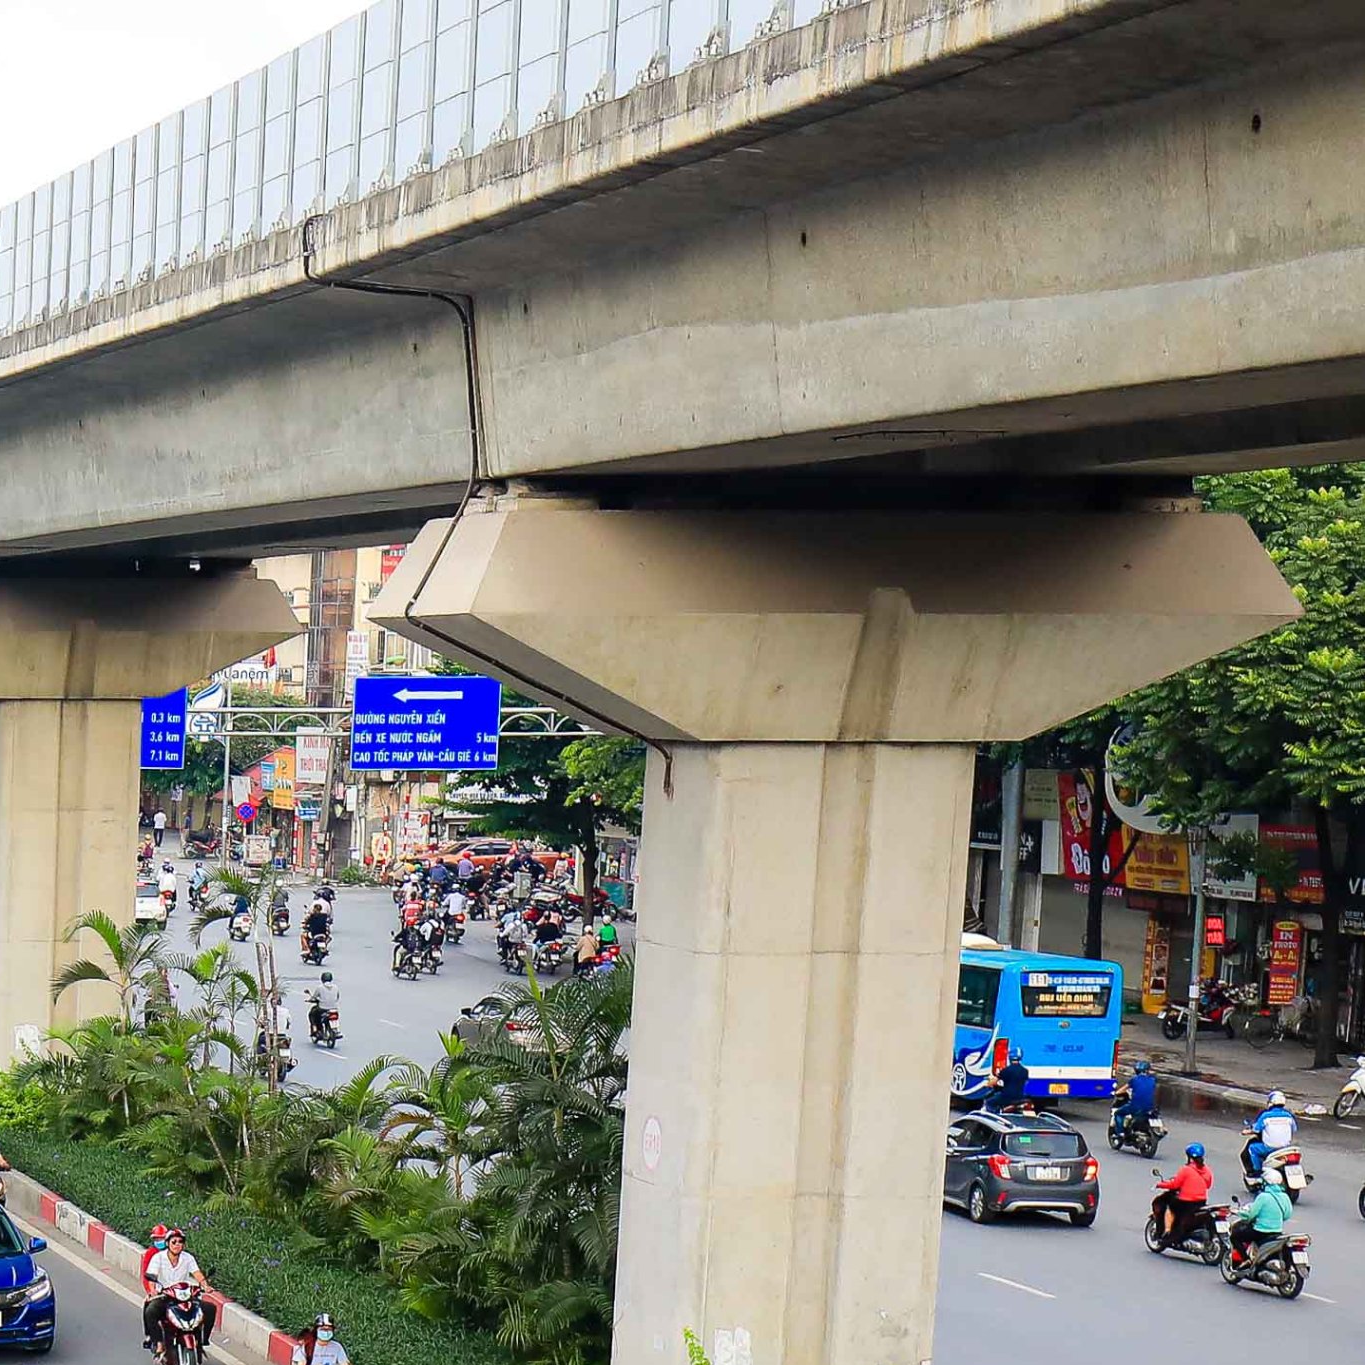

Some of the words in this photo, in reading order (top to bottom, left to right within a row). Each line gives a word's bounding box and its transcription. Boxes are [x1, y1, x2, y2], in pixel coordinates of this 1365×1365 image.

[151, 712, 164, 723] 0.3
[167, 712, 181, 723] km
[355, 710, 385, 724] ĐƯỜNG
[388, 709, 422, 724] NGUYỄN
[150, 731, 162, 742] 3.6
[165, 731, 180, 742] km
[354, 730, 372, 743] BẾN
[376, 733, 386, 743] XE
[389, 731, 413, 743] NƯỚC
[416, 730, 441, 743] NGẦM
[476, 732, 482, 743] 5
[483, 732, 497, 743] km
[150, 751, 162, 762] 7.1
[165, 750, 178, 761] km
[353, 751, 370, 762] CAO
[374, 749, 389, 762] TỐC
[392, 749, 414, 762] PHÁP
[474, 752, 479, 762] 6
[483, 751, 496, 762] km
